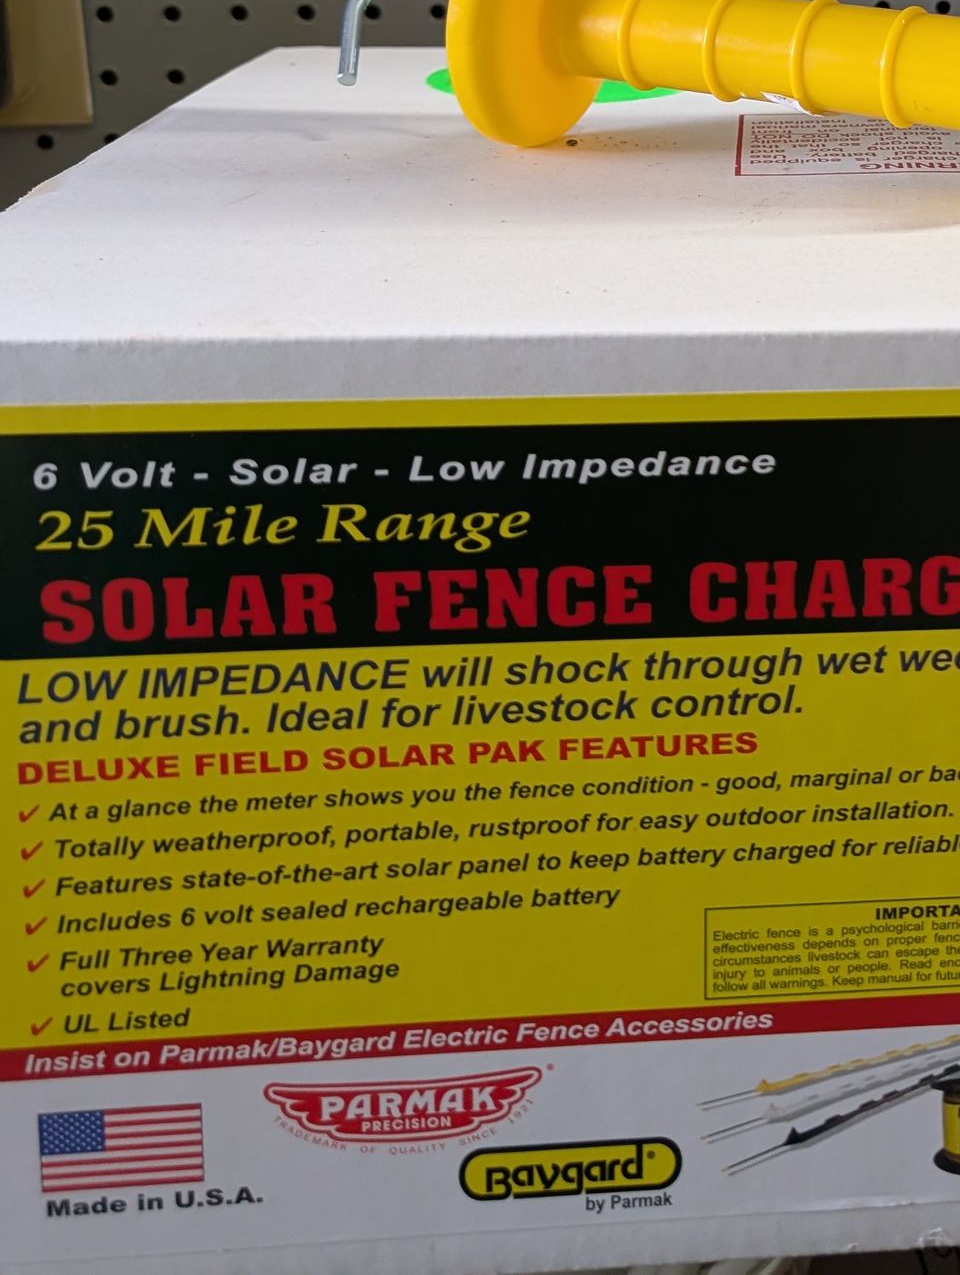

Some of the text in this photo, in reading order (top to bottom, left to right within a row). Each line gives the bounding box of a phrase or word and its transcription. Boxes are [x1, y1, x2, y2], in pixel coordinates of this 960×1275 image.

[33, 450, 776, 490] 6 Volt Solar Low Impedance
[35, 503, 531, 553] 25 Mile Range
[41, 574, 336, 643] SOLAR
[374, 565, 651, 631] FENCE
[17, 669, 127, 704] LOW
[138, 659, 410, 699] IMPEDANCE
[422, 656, 493, 688] will
[504, 652, 630, 685] shock
[643, 646, 803, 684] through
[817, 645, 888, 675] wet
[18, 680, 802, 744] and brush. Ideal for livestock control.
[18, 731, 758, 784] DELUXE FIELD SOLAR PAK FEATURES
[48, 802, 78, 821] At
[85, 805, 98, 819] a
[107, 799, 191, 823] glance
[199, 794, 238, 814] the
[245, 792, 318, 811] meter
[323, 788, 403, 807] shows
[410, 788, 456, 808] you
[464, 782, 502, 801] the
[509, 780, 575, 799] fence
[582, 775, 694, 796] condition
[715, 771, 781, 795] good,
[790, 766, 892, 790] marginal
[898, 769, 924, 783] or
[319, 1085, 498, 1122] PARMAK
[361, 1116, 452, 1132] PRECISION
[485, 1144, 644, 1196] Baygard
[47, 1186, 263, 1217] Made in U.S.A.
[585, 1192, 673, 1213] by Parmak
